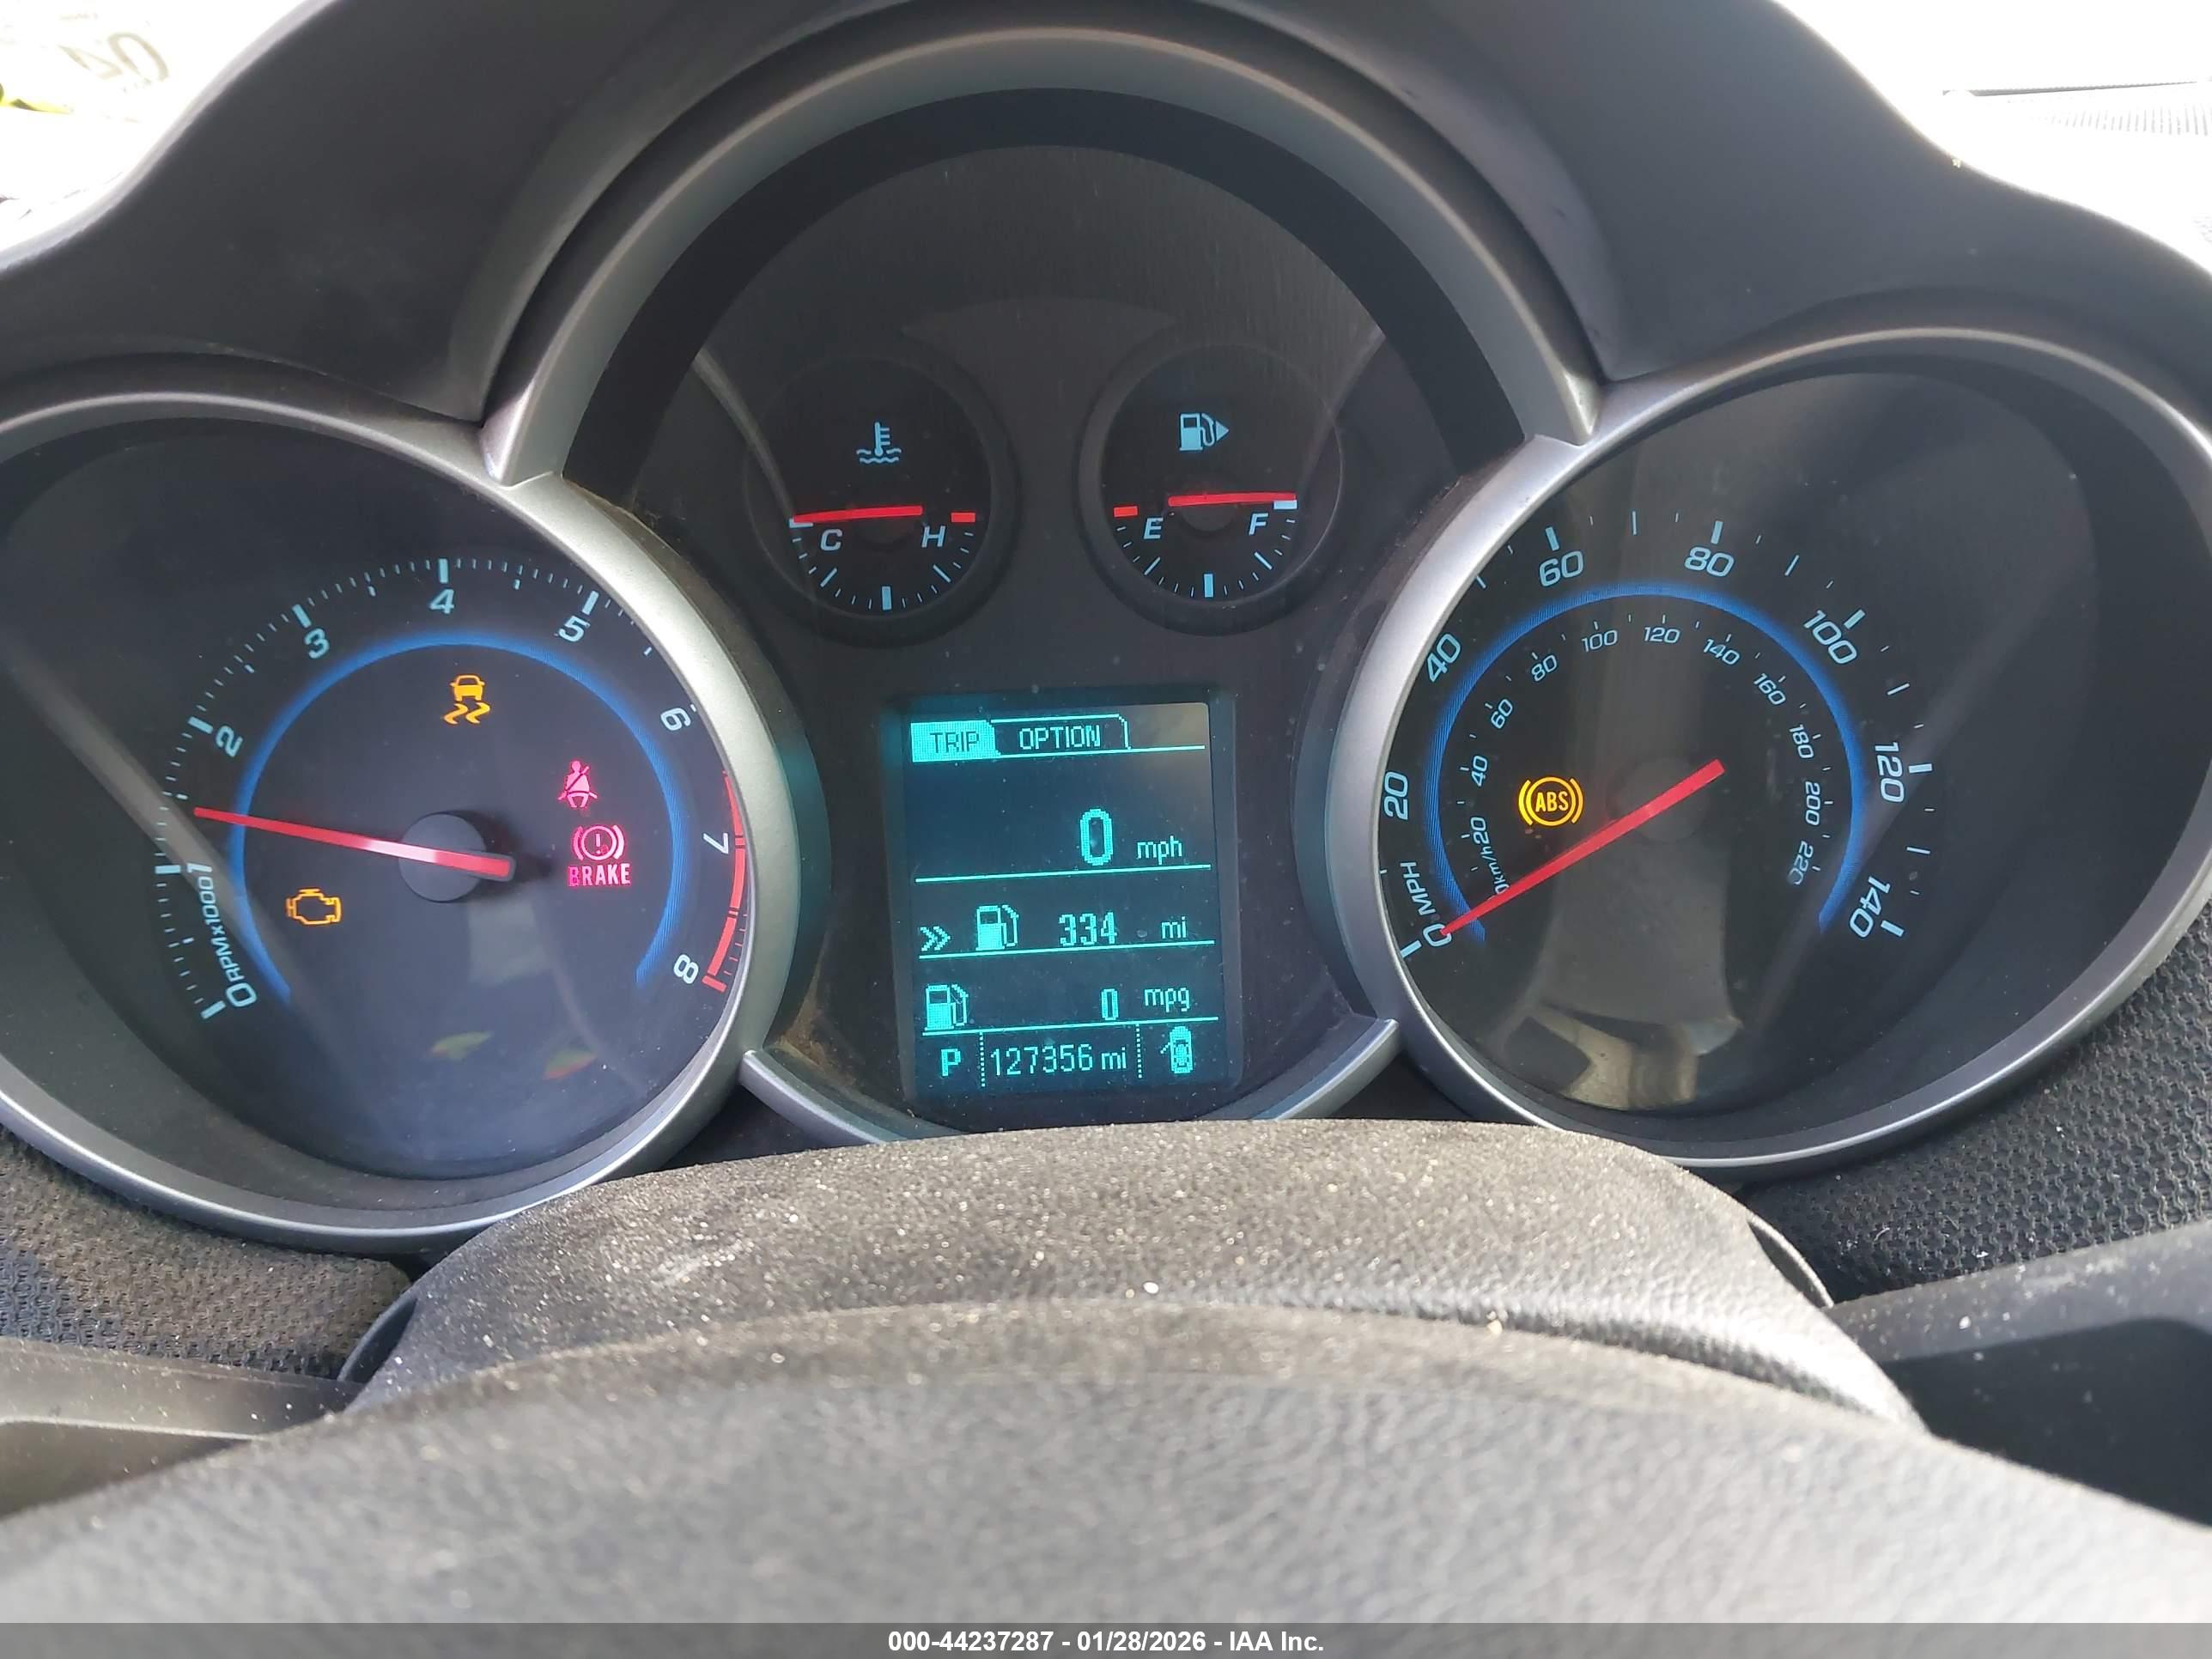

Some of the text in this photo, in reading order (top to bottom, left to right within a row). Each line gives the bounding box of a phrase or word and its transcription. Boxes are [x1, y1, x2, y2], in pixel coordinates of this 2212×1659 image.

[921, 526, 946, 548] H
[1143, 517, 1164, 539] E
[1248, 512, 1269, 536] F
[819, 529, 843, 550] C
[1538, 550, 1585, 587] 60
[1683, 546, 1735, 578] 80
[428, 588, 455, 614] 4
[304, 628, 330, 659] 3
[554, 615, 591, 643] 5
[1581, 629, 1619, 653] 100
[1643, 626, 1681, 645] 120
[1802, 609, 1858, 665] 100
[1425, 633, 1462, 684] 40
[1702, 638, 1741, 666] 140
[1530, 653, 1559, 683] 80
[1753, 672, 1787, 706] 160
[659, 706, 691, 732] 6
[1489, 697, 1514, 730] 60
[215, 726, 244, 757] 2
[929, 725, 1101, 754] TRIP OPTION
[1789, 723, 1815, 760] 180
[1470, 754, 1489, 787] 40
[1875, 741, 1905, 803] 120
[1382, 770, 1410, 822] 20
[1535, 792, 1571, 812] ABS
[1805, 781, 1821, 826] 200
[702, 831, 730, 855] 7
[1079, 808, 1182, 866] 0 mph
[1470, 816, 1489, 845] 20
[185, 862, 213, 873] 1
[568, 862, 631, 887] BRAKE
[1400, 861, 1452, 947] 0 MPH
[1849, 875, 1892, 939] 140
[1059, 911, 1188, 946] 334 mi
[672, 954, 700, 984] 8
[225, 981, 258, 1007] 0
[1100, 987, 1191, 1021] 0 mpg
[940, 1043, 1127, 1077] P 127356 mi
